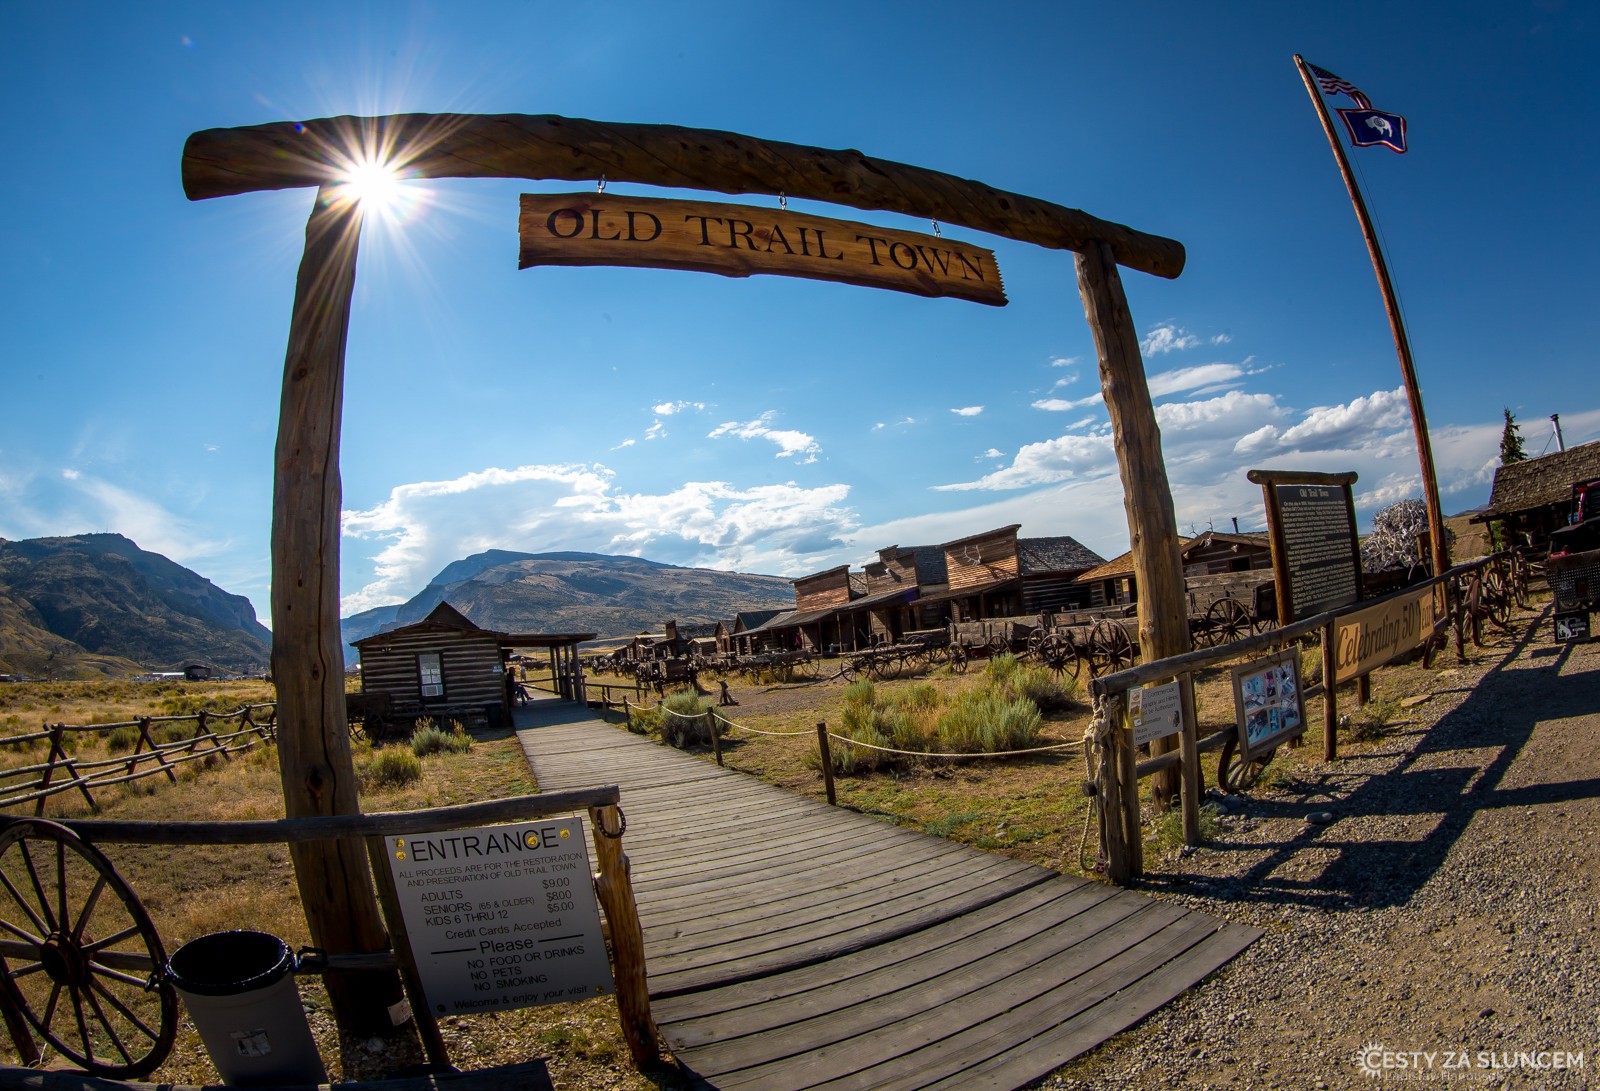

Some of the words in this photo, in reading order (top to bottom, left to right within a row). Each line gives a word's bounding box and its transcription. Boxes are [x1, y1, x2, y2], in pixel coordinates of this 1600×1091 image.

[546, 207, 662, 242] OLD
[684, 214, 844, 261] TRAIL
[855, 234, 986, 282] TOWN
[1335, 615, 1400, 671] Celebrating
[1402, 602, 1414, 639] 50
[410, 827, 559, 862] ENTRANCE
[399, 870, 414, 879] ALL
[415, 866, 462, 877] PROCEEDS
[465, 864, 483, 873] ARE
[484, 862, 502, 871] FOR
[504, 860, 520, 868] THE
[523, 852, 583, 867] RESTORATION
[407, 879, 424, 888] AND
[426, 873, 488, 886] PRESERVATION
[490, 871, 501, 880] OF
[503, 869, 521, 878] OLD
[524, 866, 549, 876] TRAIL
[551, 862, 576, 873] TOWN
[542, 877, 570, 889] $9.00
[421, 889, 463, 902] ADULTS
[424, 902, 473, 915] SENIORS
[478, 901, 492, 911] (65
[494, 900, 500, 908] &
[502, 896, 535, 908] OLDER)
[547, 901, 575, 913] $5.00
[425, 915, 452, 927] KIDS
[454, 914, 462, 924] 6
[464, 911, 495, 922] THRU
[497, 909, 509, 919] 12
[445, 928, 476, 940] Credit
[479, 923, 510, 937] Cards
[513, 918, 562, 932] Accepted
[479, 938, 534, 954] Please
[467, 959, 484, 969] NO
[489, 954, 522, 967] FOOD
[524, 951, 542, 962] OR
[544, 945, 585, 959] DRINKS
[470, 970, 488, 981] NO
[492, 966, 522, 978] PETS
[473, 981, 491, 992] NO
[496, 974, 548, 990] SMOKING
[453, 998, 499, 1010] Welcome
[502, 994, 511, 1004] &
[512, 992, 539, 1004] enjoy
[543, 989, 565, 1001] your
[567, 985, 587, 996] visit
